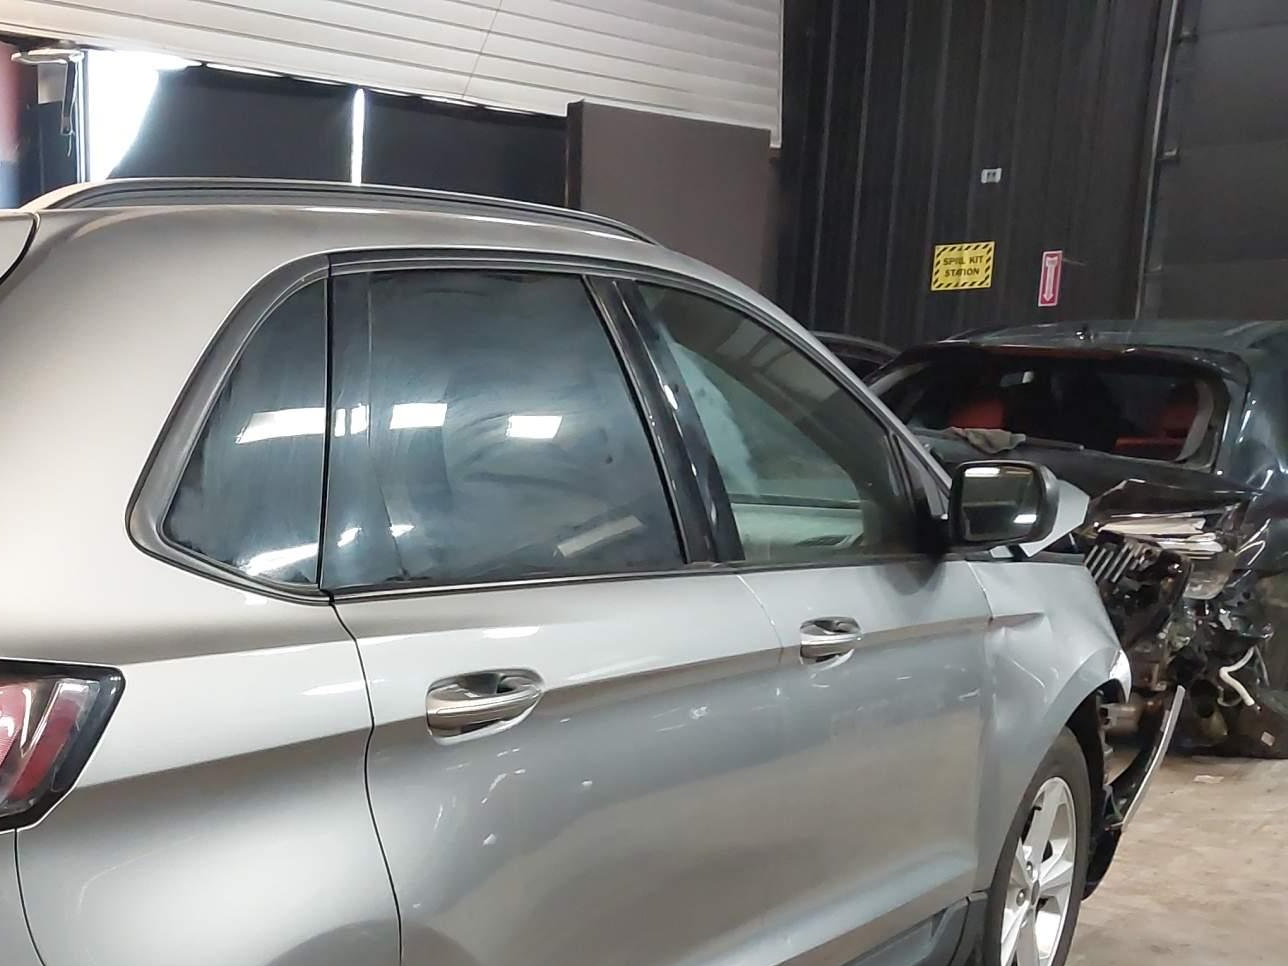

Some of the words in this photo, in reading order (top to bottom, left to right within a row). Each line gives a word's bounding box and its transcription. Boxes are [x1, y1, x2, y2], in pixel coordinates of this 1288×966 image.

[943, 257, 966, 266] SPILL
[969, 255, 984, 264] KIT
[944, 267, 980, 278] STATION
